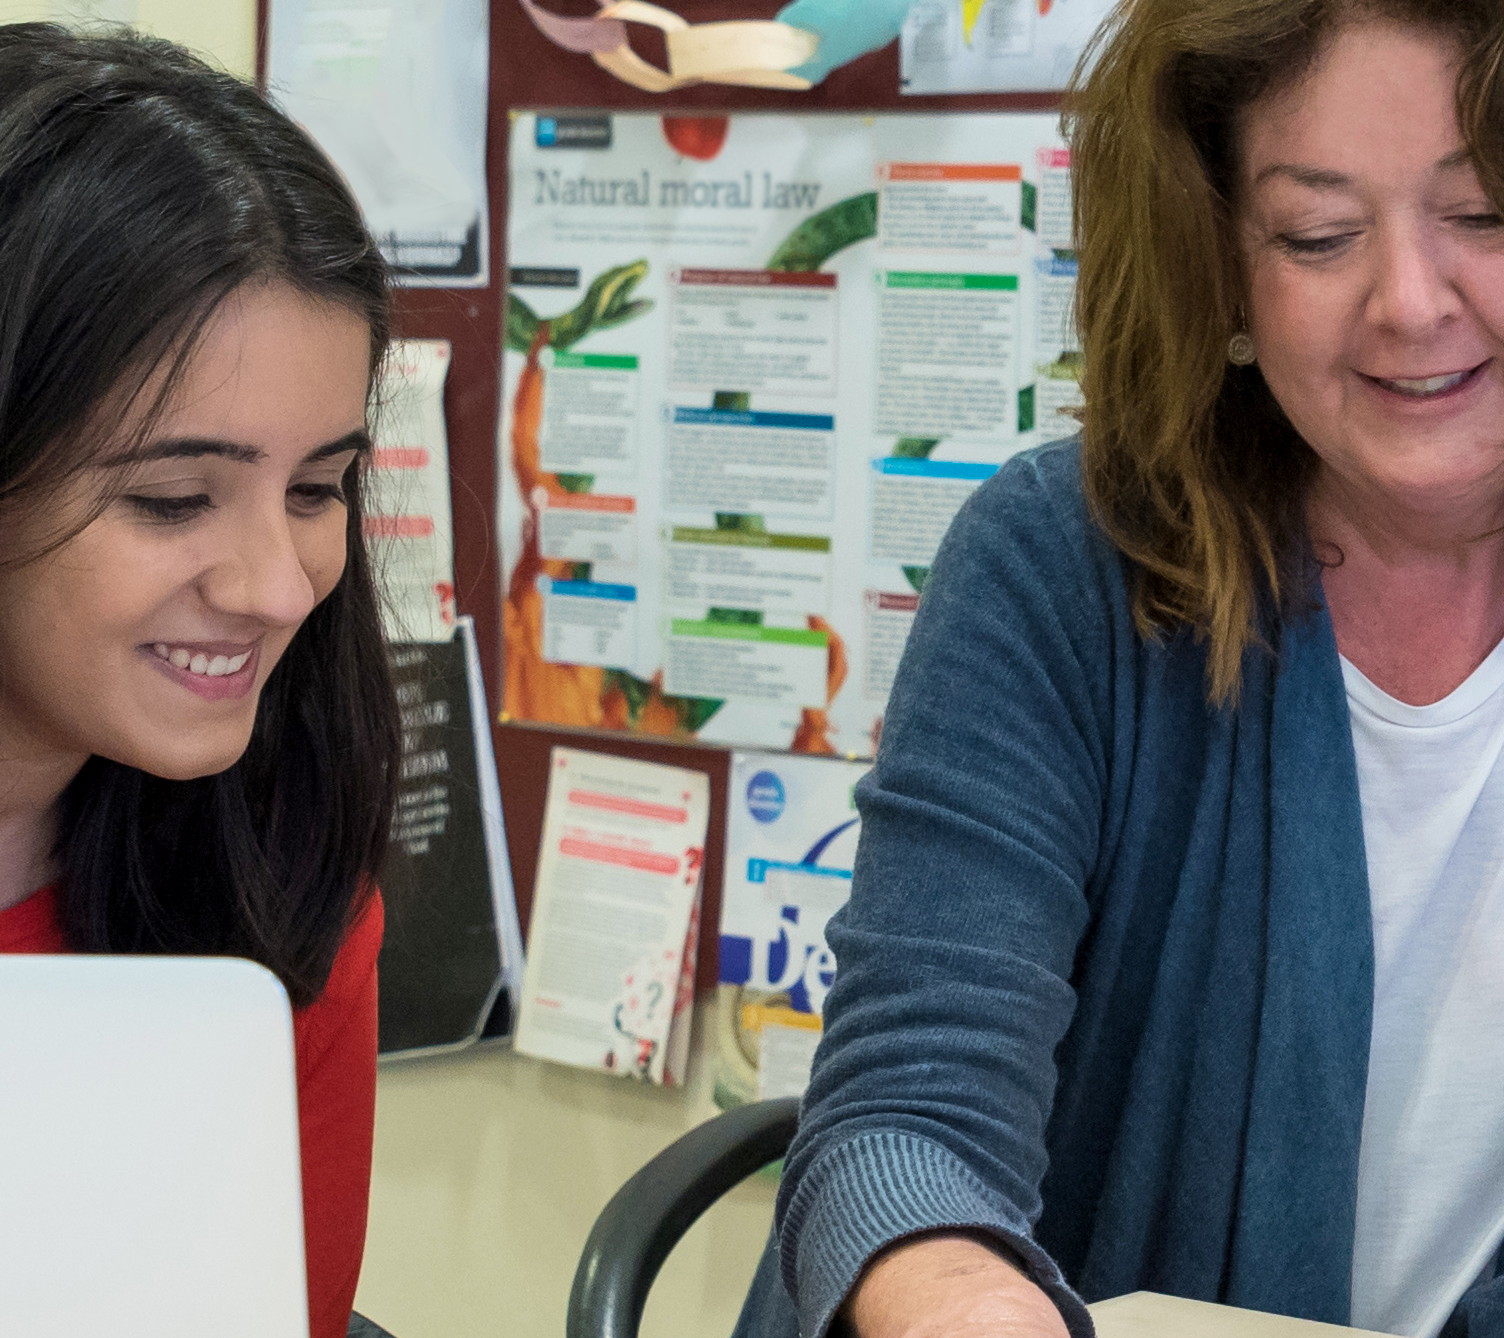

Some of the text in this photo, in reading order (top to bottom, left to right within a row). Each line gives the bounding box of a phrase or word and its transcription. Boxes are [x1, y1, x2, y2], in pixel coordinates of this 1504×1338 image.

[534, 168, 821, 209] Natural moral law
